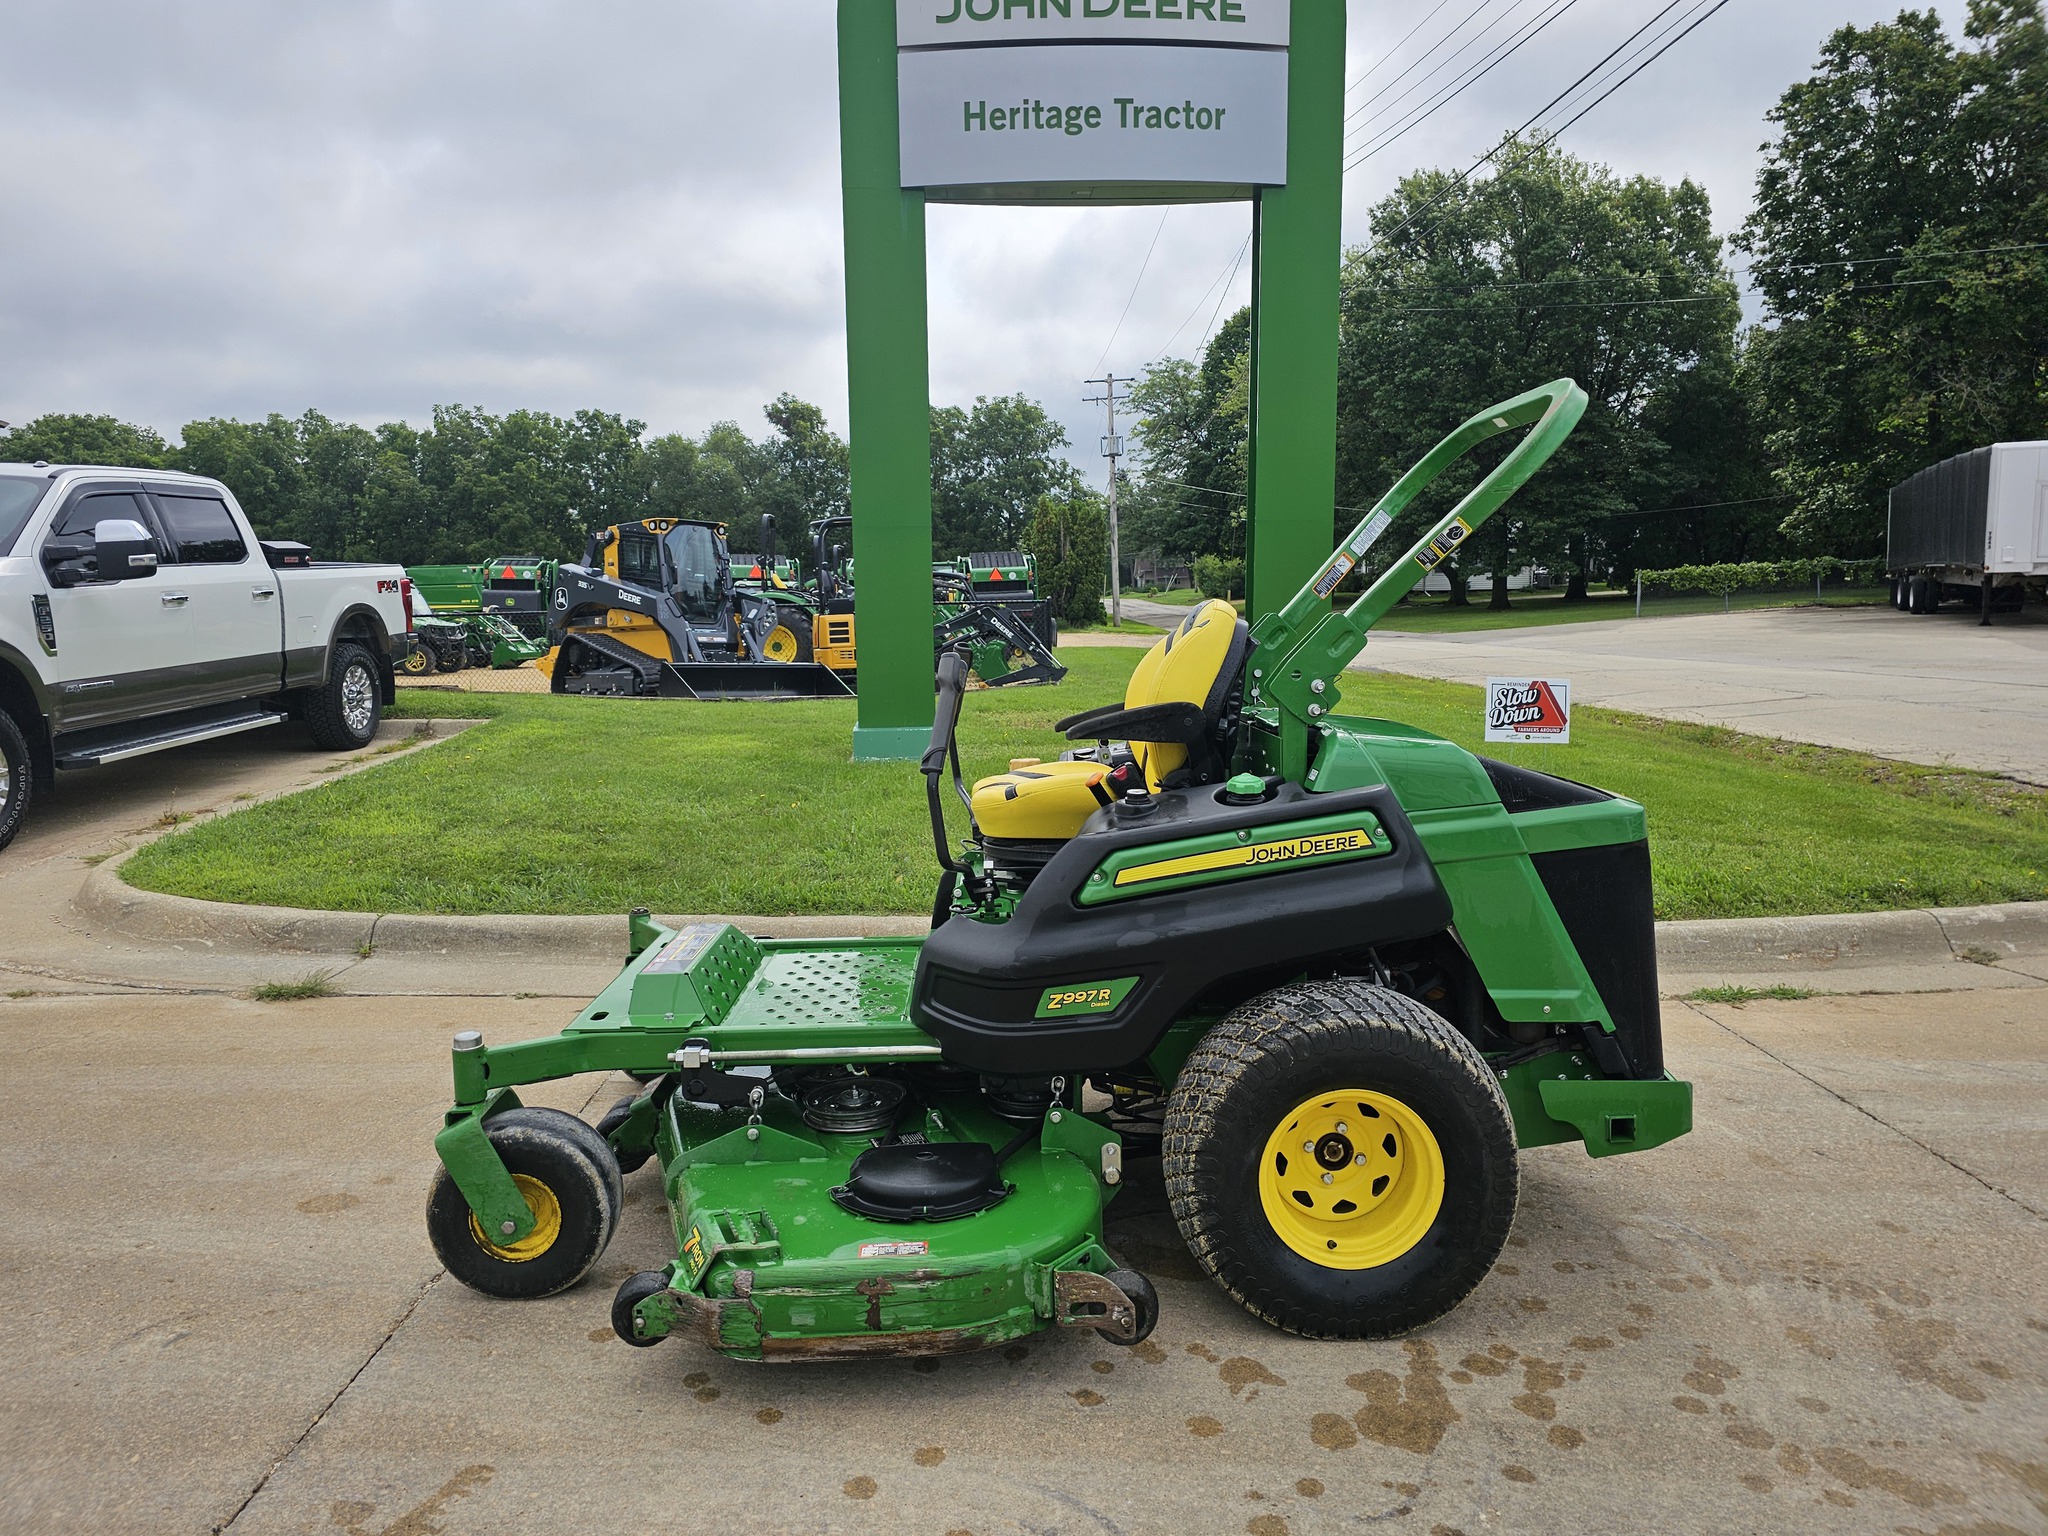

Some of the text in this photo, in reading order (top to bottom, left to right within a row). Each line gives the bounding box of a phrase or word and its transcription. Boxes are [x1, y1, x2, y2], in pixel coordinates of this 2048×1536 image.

[936, 0, 1246, 24] JOHN DEERE
[963, 97, 1226, 136] Heritage Tractor
[376, 579, 399, 594] FX4
[618, 589, 642, 605] DEERE
[990, 616, 1015, 639] DEERE
[1493, 687, 1540, 709] Slow
[1489, 704, 1544, 728] Down
[1245, 835, 1359, 863] JOHN DEERE
[1090, 1000, 1111, 1009] Diesel
